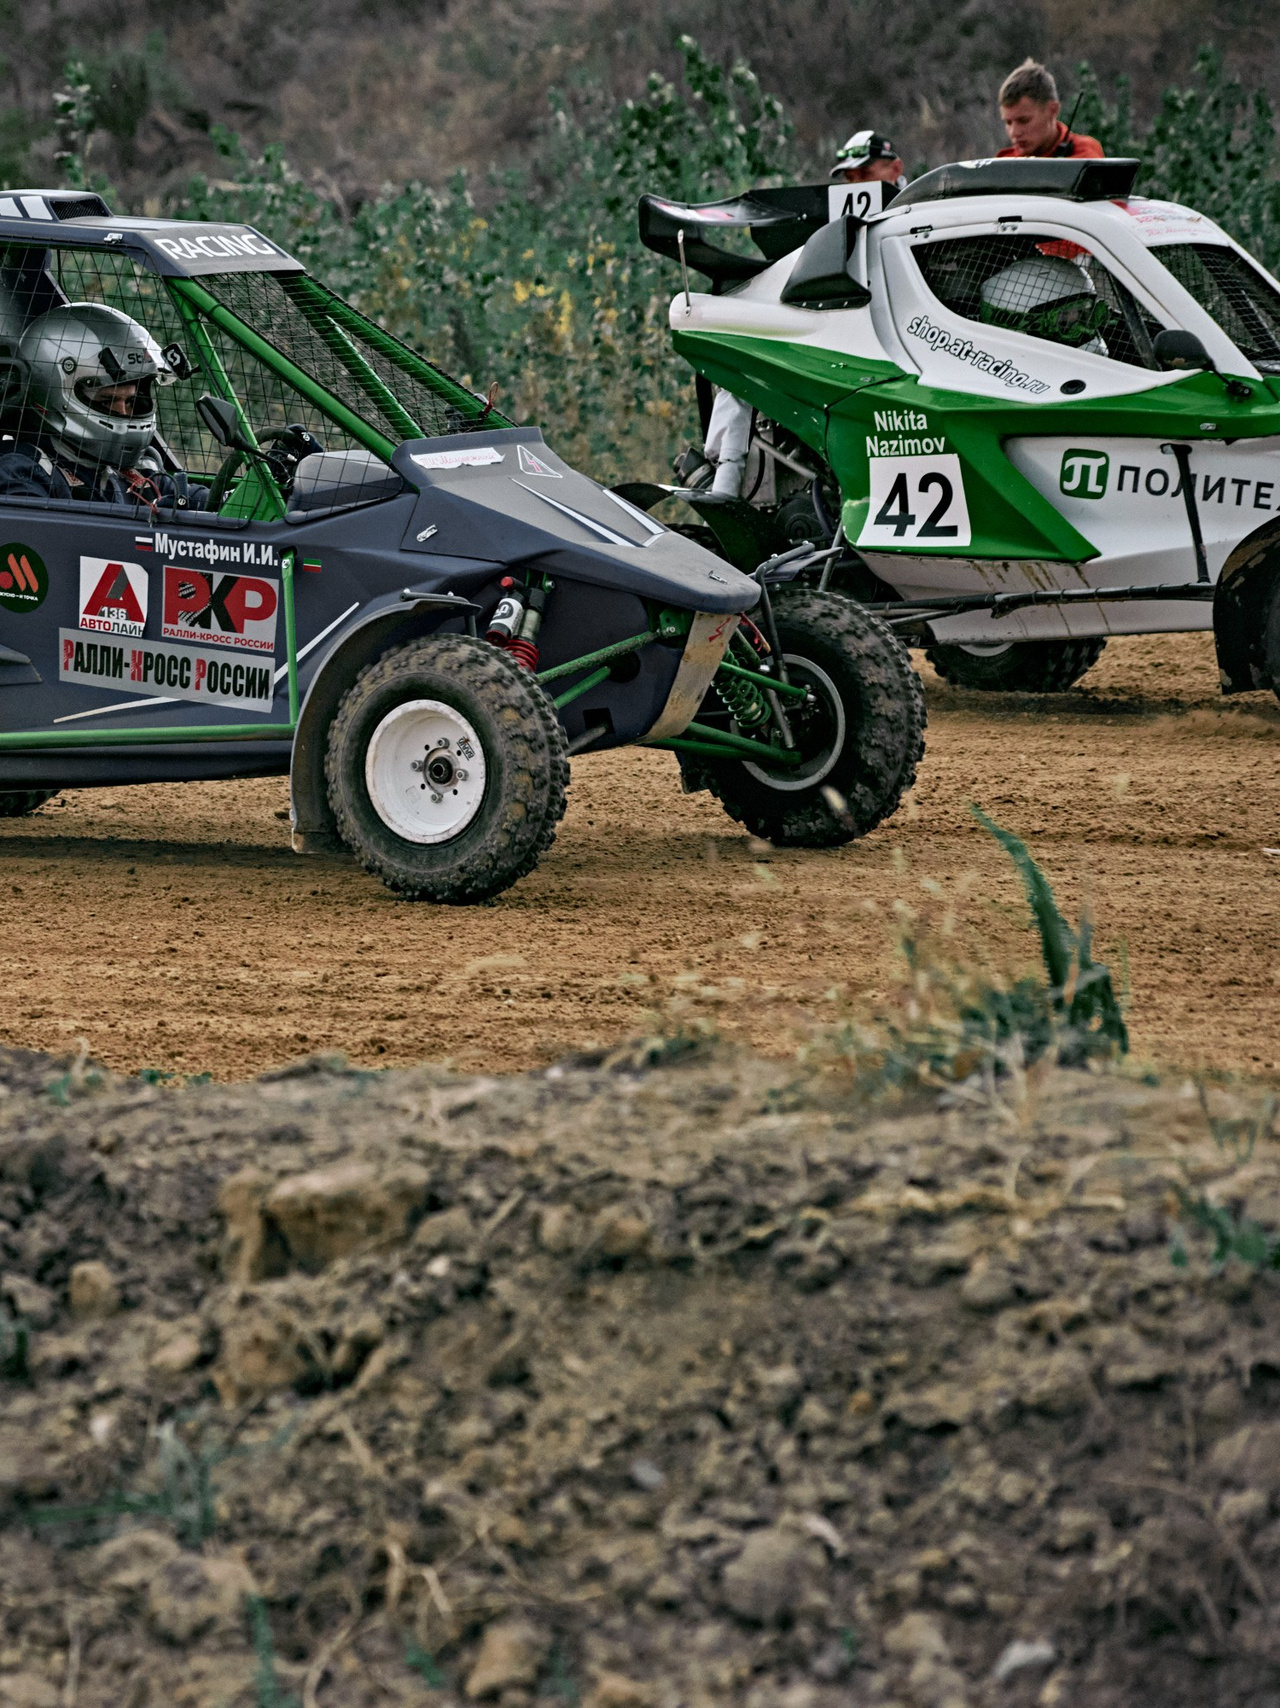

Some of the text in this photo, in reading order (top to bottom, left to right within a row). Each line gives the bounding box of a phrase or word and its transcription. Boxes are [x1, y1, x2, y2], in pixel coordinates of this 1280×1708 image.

[841, 191, 872, 219] 42
[154, 234, 277, 260] RACING
[907, 315, 1051, 394] shop.at-racing.ru
[873, 409, 928, 432] Nikita
[865, 434, 946, 457] Nazimov
[1117, 465, 1280, 511] ПОЛИТЕ
[873, 472, 959, 538] 42
[155, 532, 279, 567] Мустафин И.И.
[101, 606, 127, 621] 136
[163, 627, 274, 650] РАЛЛИ-КРОСС РОССИИ
[63, 639, 270, 700] РАЛЛИ-КРОСС РОССИИ
